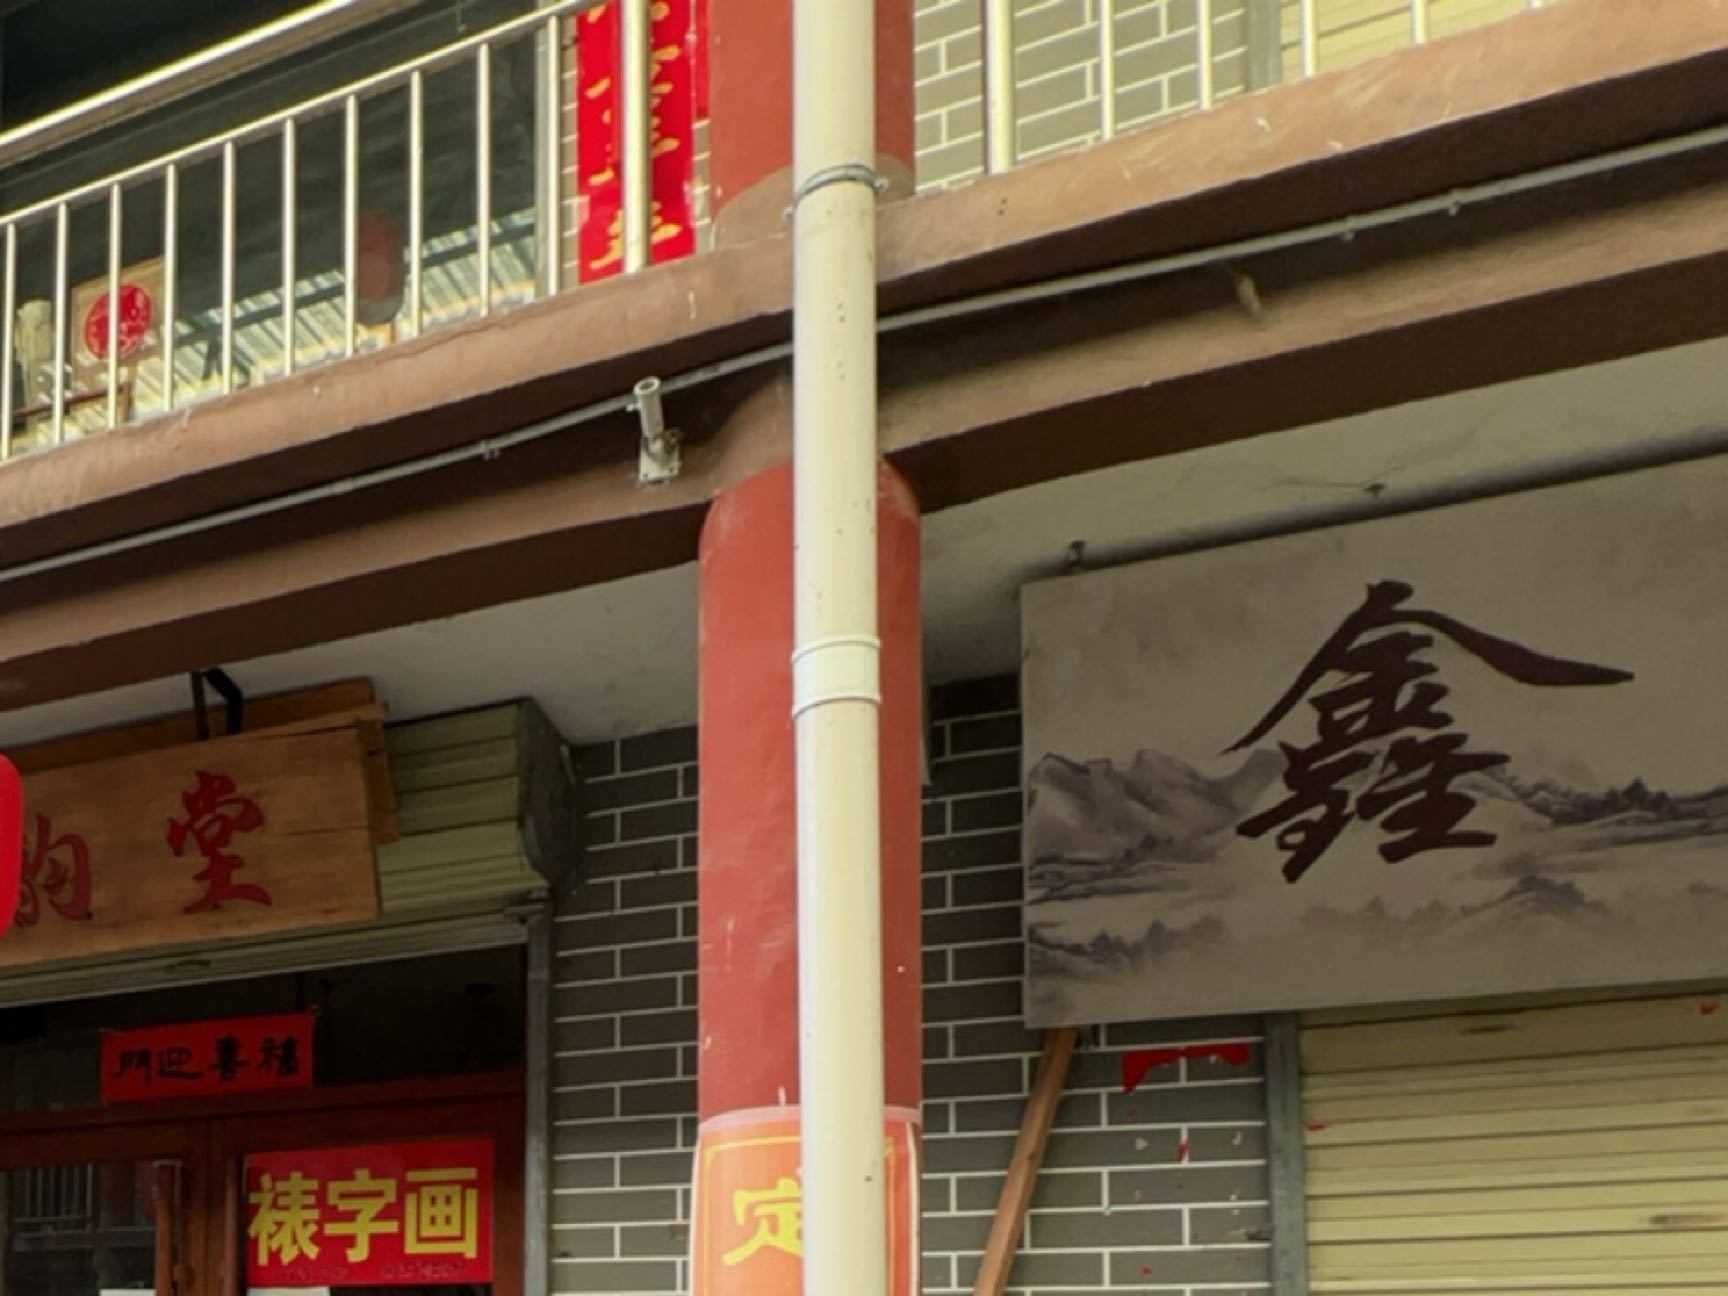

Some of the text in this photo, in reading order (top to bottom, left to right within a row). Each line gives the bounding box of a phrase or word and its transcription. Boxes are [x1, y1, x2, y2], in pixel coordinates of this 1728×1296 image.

[1221, 580, 1636, 884] 鑫
[248, 1167, 479, 1267] 裱字画
